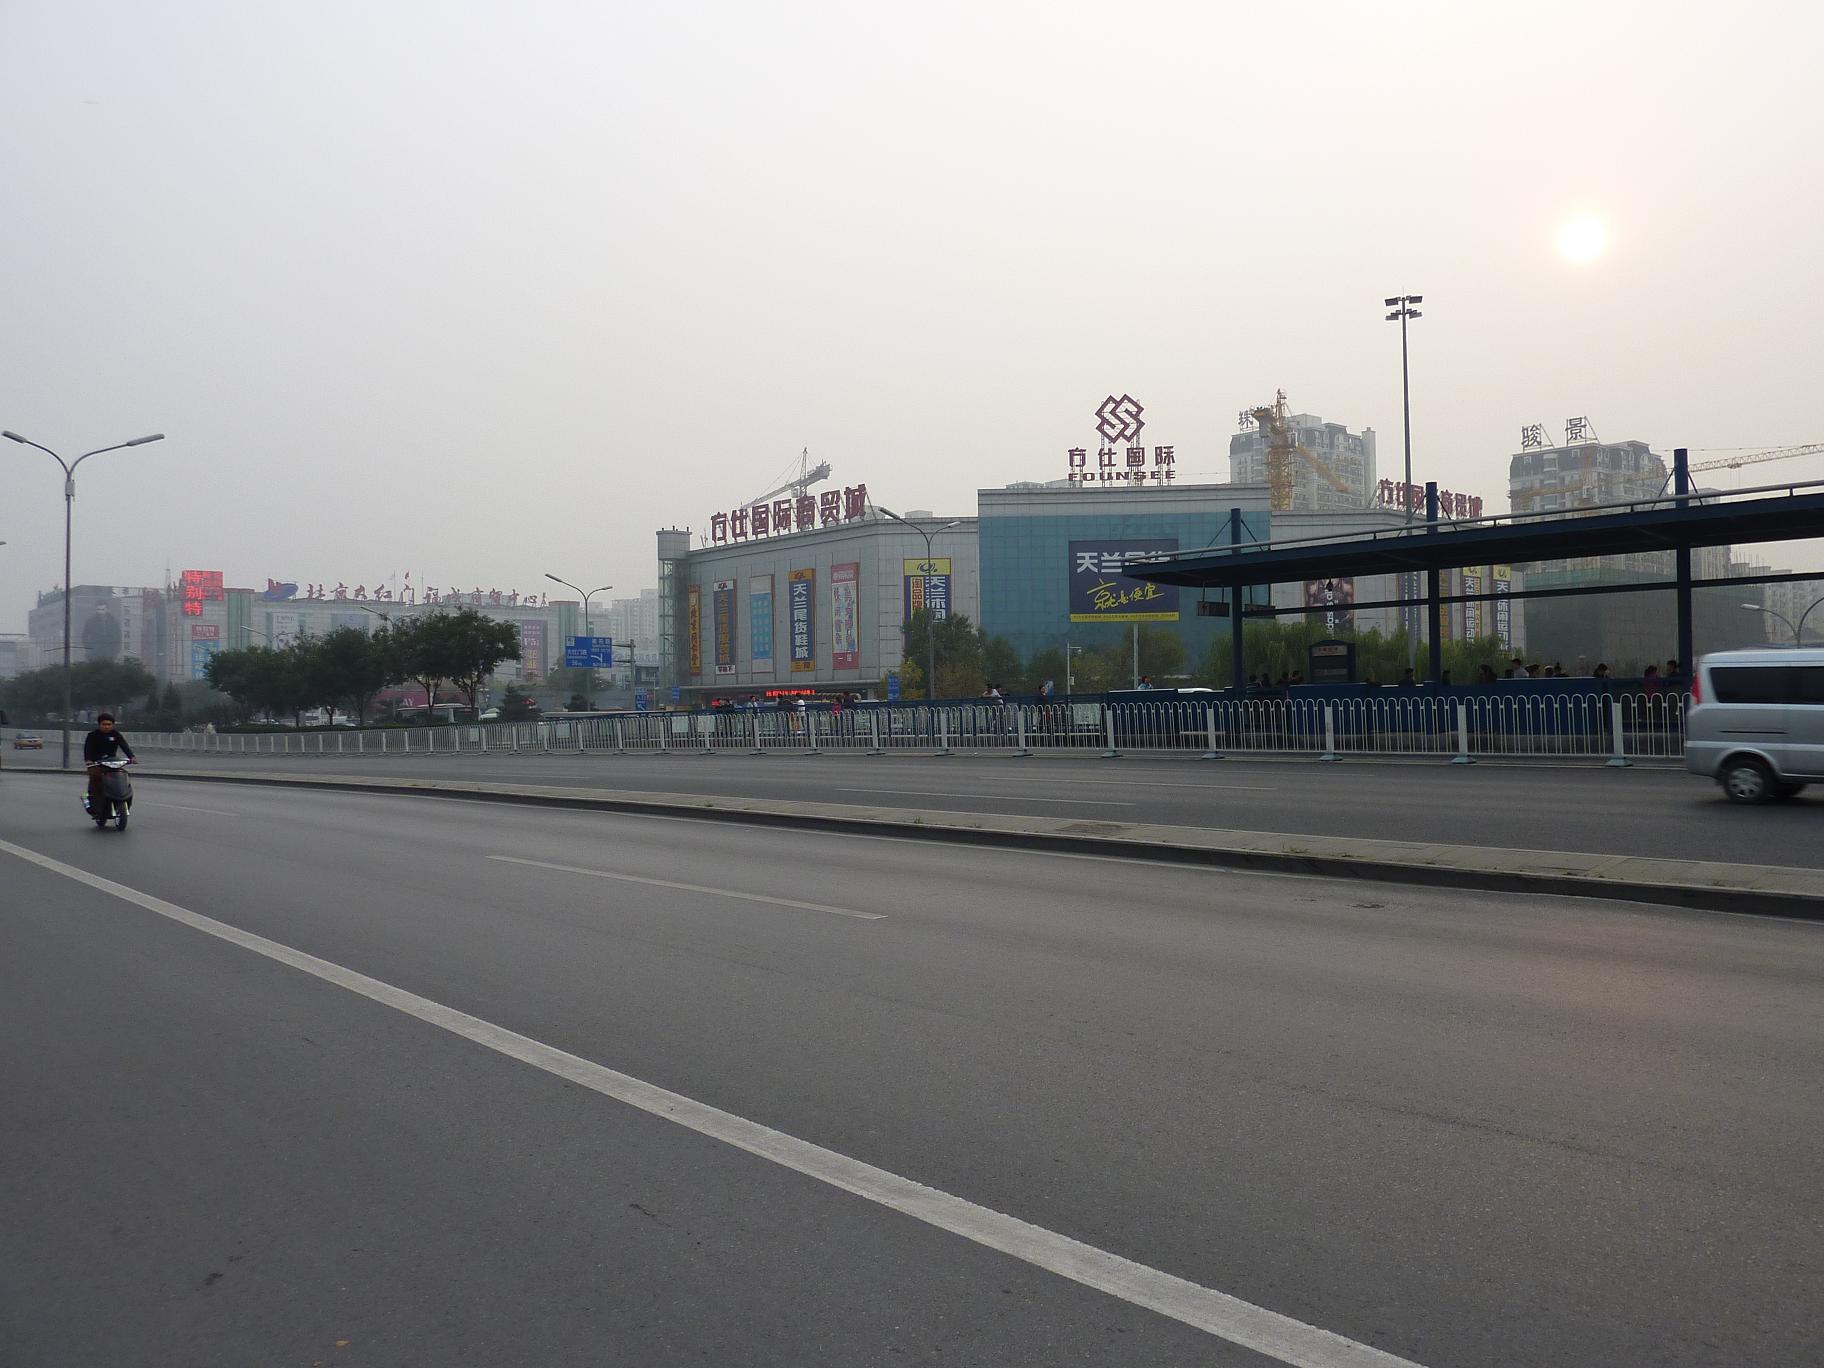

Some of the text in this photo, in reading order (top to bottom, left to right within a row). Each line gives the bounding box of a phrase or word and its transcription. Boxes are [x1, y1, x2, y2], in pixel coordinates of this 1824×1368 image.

[1521, 417, 1587, 448] 骏景
[1068, 446, 1176, 470] 方仕国际
[1068, 471, 1176, 482] FOUNSEE
[711, 483, 867, 543] 方仕国际商贸城
[1379, 478, 1484, 518] 方仕国商贸城
